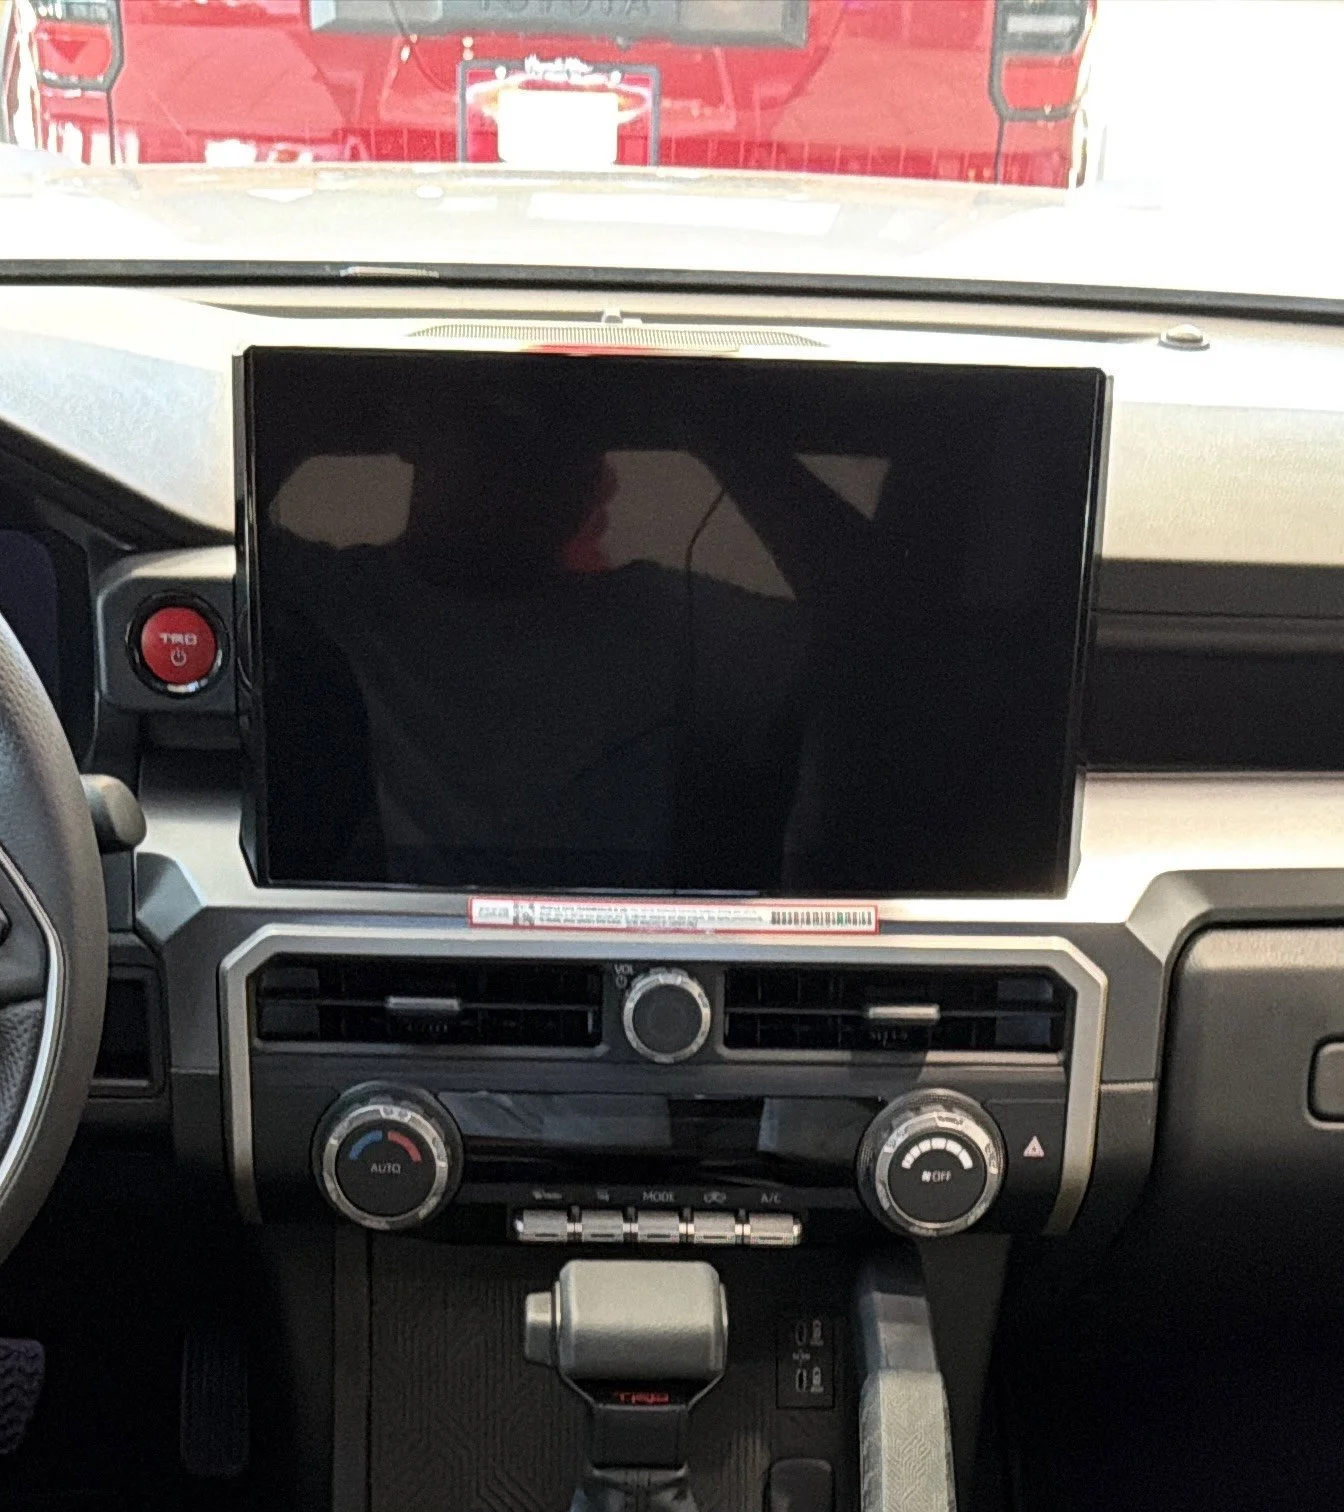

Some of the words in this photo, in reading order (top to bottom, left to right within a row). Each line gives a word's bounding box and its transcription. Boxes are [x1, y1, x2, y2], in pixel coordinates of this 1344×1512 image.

[159, 632, 198, 646] TRD
[614, 963, 634, 975] VOL
[370, 1162, 401, 1175] AUTO
[932, 1170, 952, 1182] OFF
[642, 1191, 674, 1202] MODE
[760, 1191, 782, 1204] A/C
